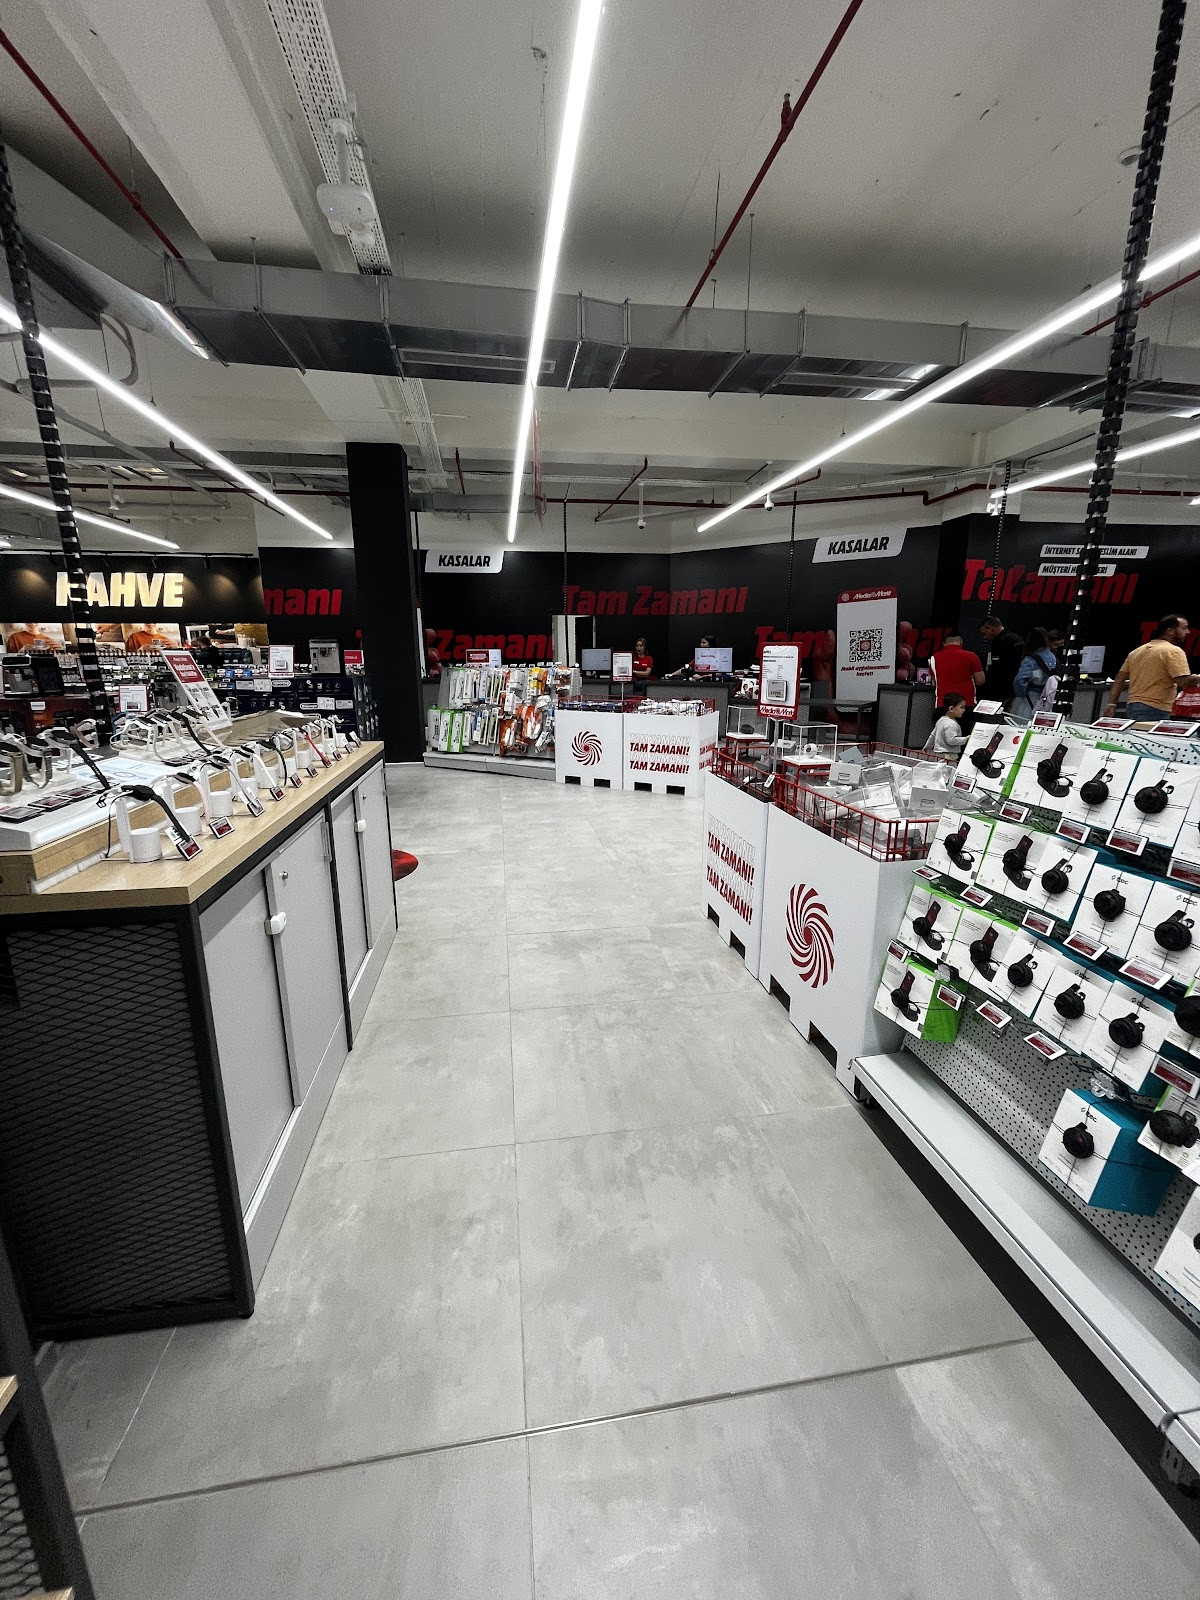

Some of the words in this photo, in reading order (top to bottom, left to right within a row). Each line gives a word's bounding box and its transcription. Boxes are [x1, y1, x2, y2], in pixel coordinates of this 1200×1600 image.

[828, 537, 889, 555] KASALAR
[438, 554, 491, 567] KASALAR
[1042, 564, 1071, 575] MÜŞTERİ
[562, 584, 628, 616] Tam
[630, 742, 648, 752] TAM
[649, 743, 691, 756] ZAMANI!
[629, 760, 648, 771] TAM
[649, 762, 690, 774] ZAMANI!
[707, 830, 721, 857] TAM
[720, 842, 755, 886] ZAMANI!
[706, 864, 719, 891] TAM
[719, 878, 753, 926] ZAMANI!
